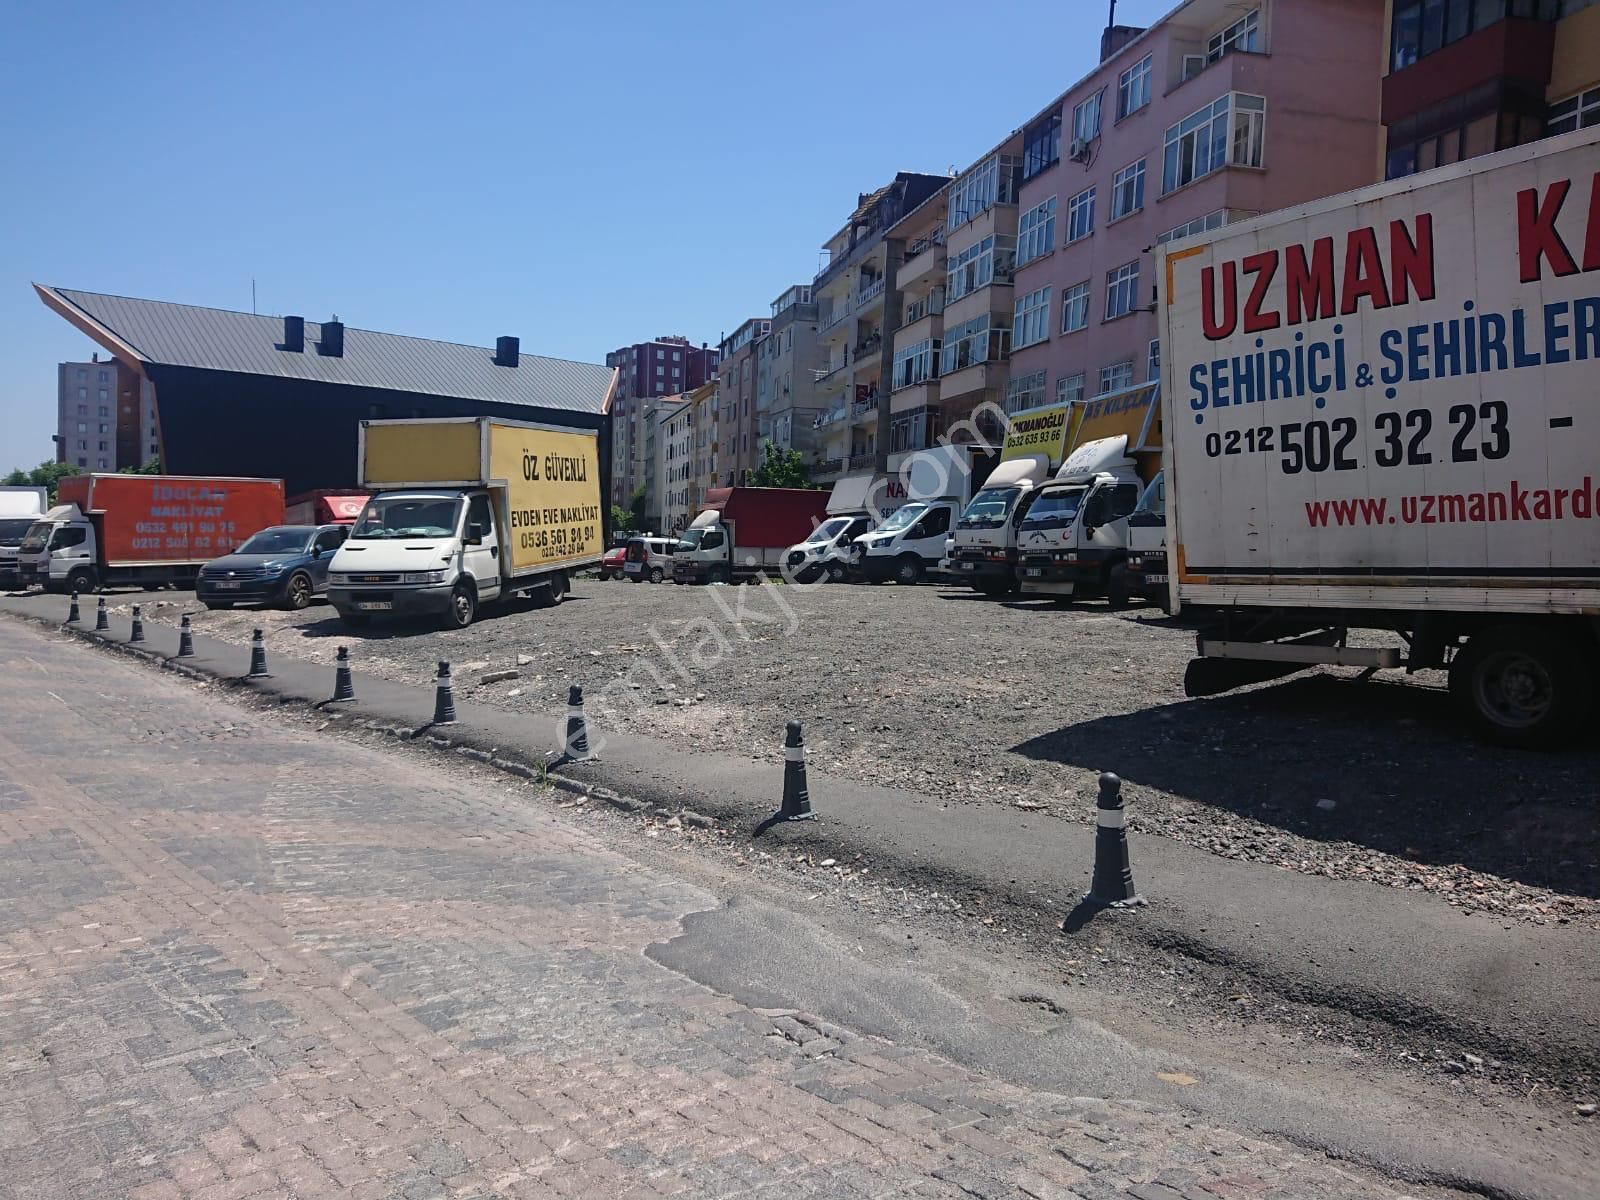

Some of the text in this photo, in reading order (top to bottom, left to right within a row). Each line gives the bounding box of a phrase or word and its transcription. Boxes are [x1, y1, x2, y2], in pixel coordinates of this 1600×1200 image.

[1201, 212, 1436, 342] UZMAN
[1189, 323, 1347, 425] ŞEHİRİÇİ
[1354, 362, 1375, 389] &
[1007, 429, 1061, 448] 0532 635 93 66
[1205, 426, 1275, 458] 0212
[522, 448, 587, 482] ÖZ GÜVENLİ
[511, 502, 599, 528] EVDEN EVE NAKLİYAT
[521, 529, 548, 549] 0536
[550, 528, 567, 546] 561
